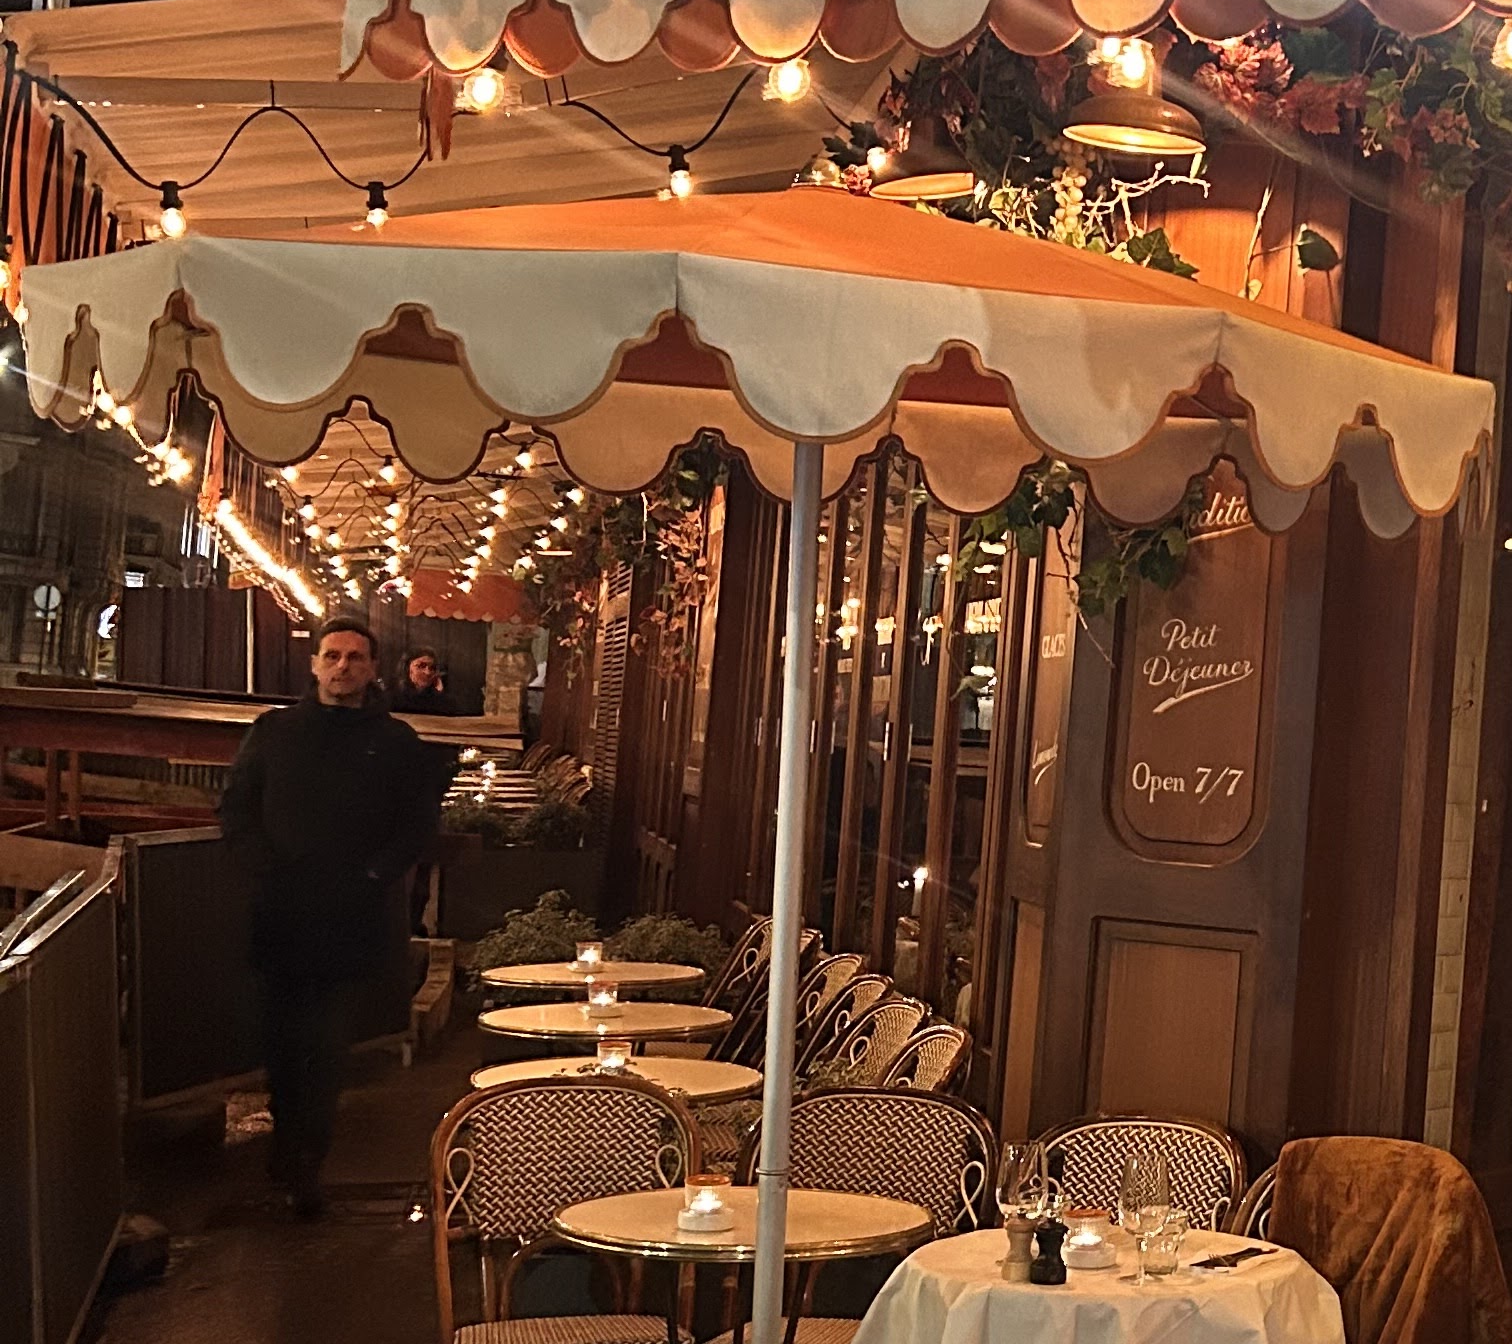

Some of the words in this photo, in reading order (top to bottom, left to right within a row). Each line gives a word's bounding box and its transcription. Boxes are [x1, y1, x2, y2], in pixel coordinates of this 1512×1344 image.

[1161, 618, 1221, 651] Petit
[1143, 656, 1254, 698] Déjeuner
[1132, 762, 1185, 803] Open
[1195, 767, 1244, 804] 7/7
